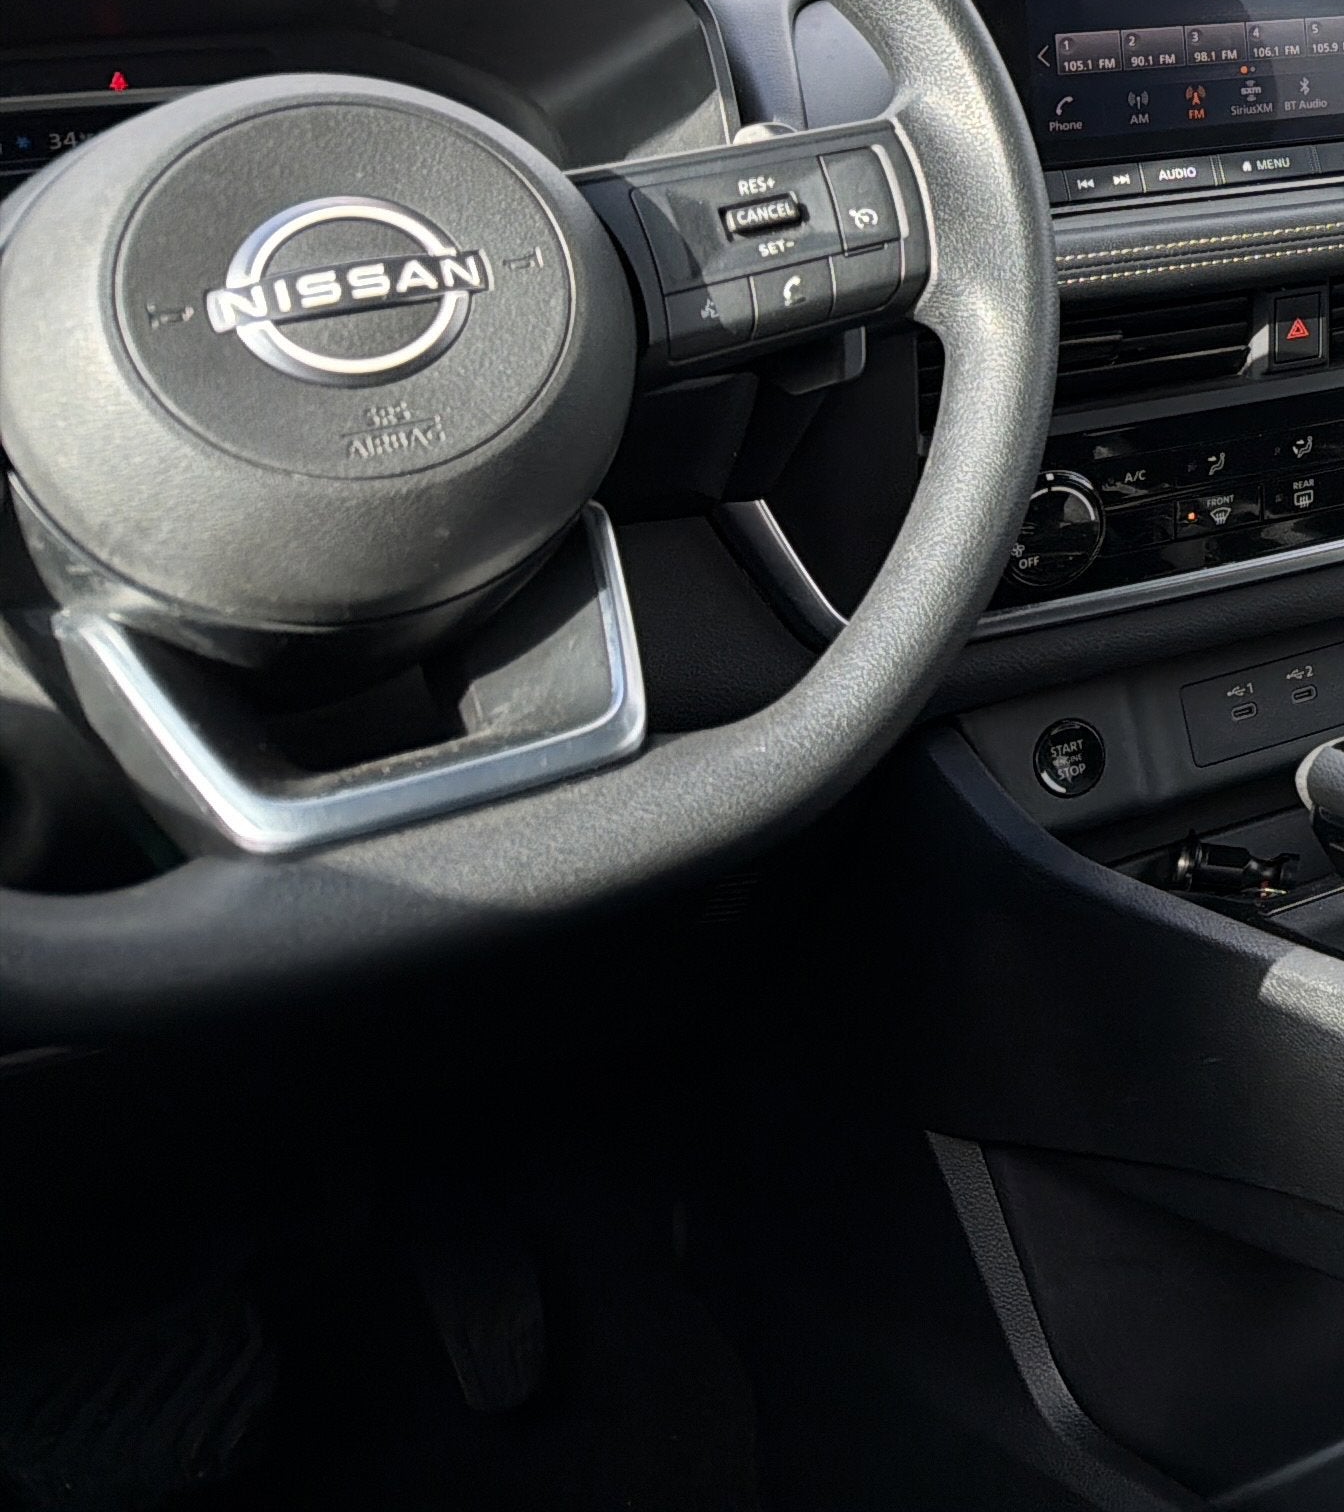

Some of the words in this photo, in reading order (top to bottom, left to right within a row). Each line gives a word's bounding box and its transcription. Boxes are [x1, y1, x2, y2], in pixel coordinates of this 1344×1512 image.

[1252, 27, 1260, 38] 4
[1311, 24, 1319, 34] 5
[1128, 36, 1136, 47] 2
[1191, 32, 1199, 42] 3
[1063, 40, 1070, 50] 1
[1253, 46, 1279, 58] 106.1
[1285, 44, 1300, 56] FM
[1312, 43, 1338, 54] 105.9
[1130, 56, 1153, 67] 90.1
[1159, 54, 1176, 65] FM
[1194, 50, 1216, 62] 98.1
[1221, 49, 1238, 61] FM
[1063, 60, 1093, 72] 105.1
[1099, 58, 1116, 70] FM
[1231, 102, 1273, 116] SiriusXM
[1284, 100, 1297, 111] BT
[1299, 98, 1328, 109] Audio
[1130, 113, 1149, 124] AM
[1188, 109, 1205, 120] FM
[1049, 119, 1083, 132] Phone
[1256, 157, 1290, 170] MENU
[1158, 166, 1197, 181] AUDIO
[738, 176, 776, 196] RES+
[736, 202, 797, 226] CANCEL
[758, 238, 795, 258] SET-
[220, 256, 481, 330] NISSAN
[1125, 470, 1146, 483] A/C
[1293, 478, 1314, 490] REAR
[1207, 495, 1234, 507] FRONT
[1018, 555, 1040, 569] OFF
[1305, 665, 1314, 677] 2
[1246, 682, 1254, 694] 1
[1050, 739, 1083, 758] START
[1057, 763, 1086, 781] STOP
